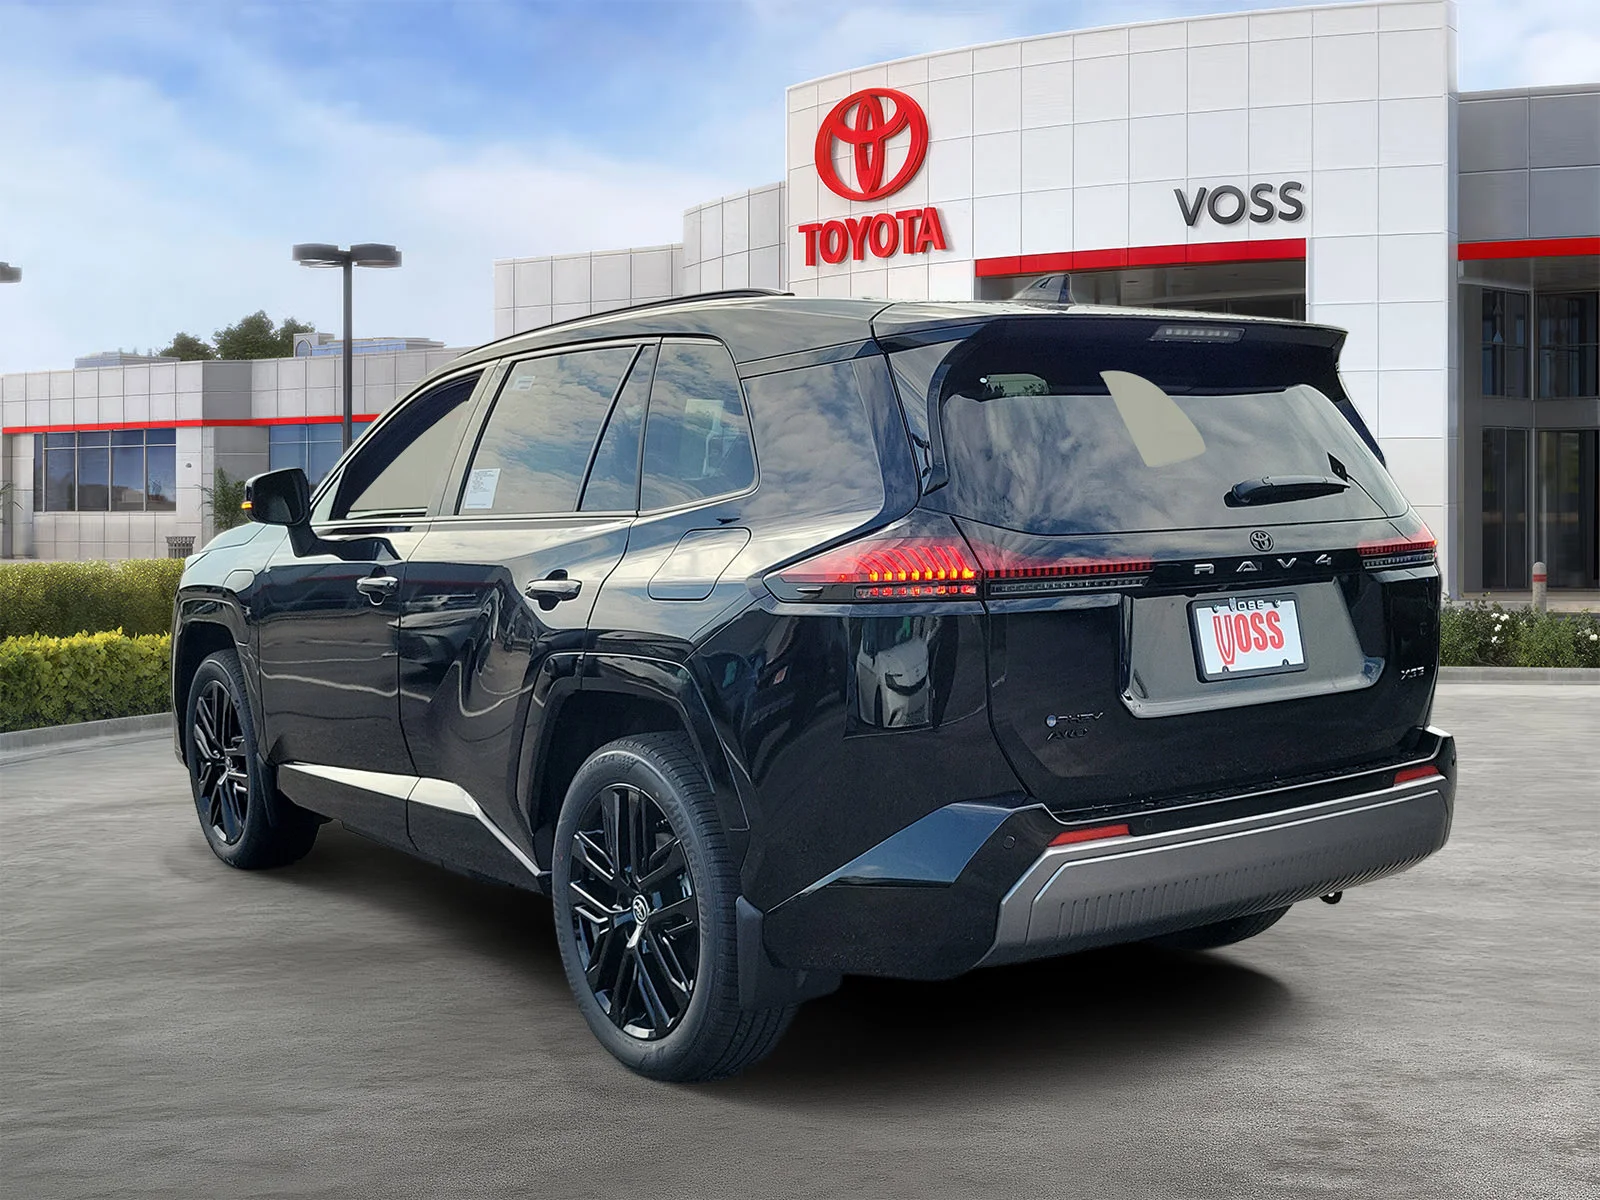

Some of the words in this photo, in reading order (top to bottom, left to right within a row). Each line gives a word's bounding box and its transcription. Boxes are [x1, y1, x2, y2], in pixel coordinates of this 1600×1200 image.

[1173, 181, 1304, 226] VOSS
[798, 207, 947, 266] TOYOTA
[1194, 553, 1332, 575] RAV4
[1212, 609, 1285, 665] VOSS
